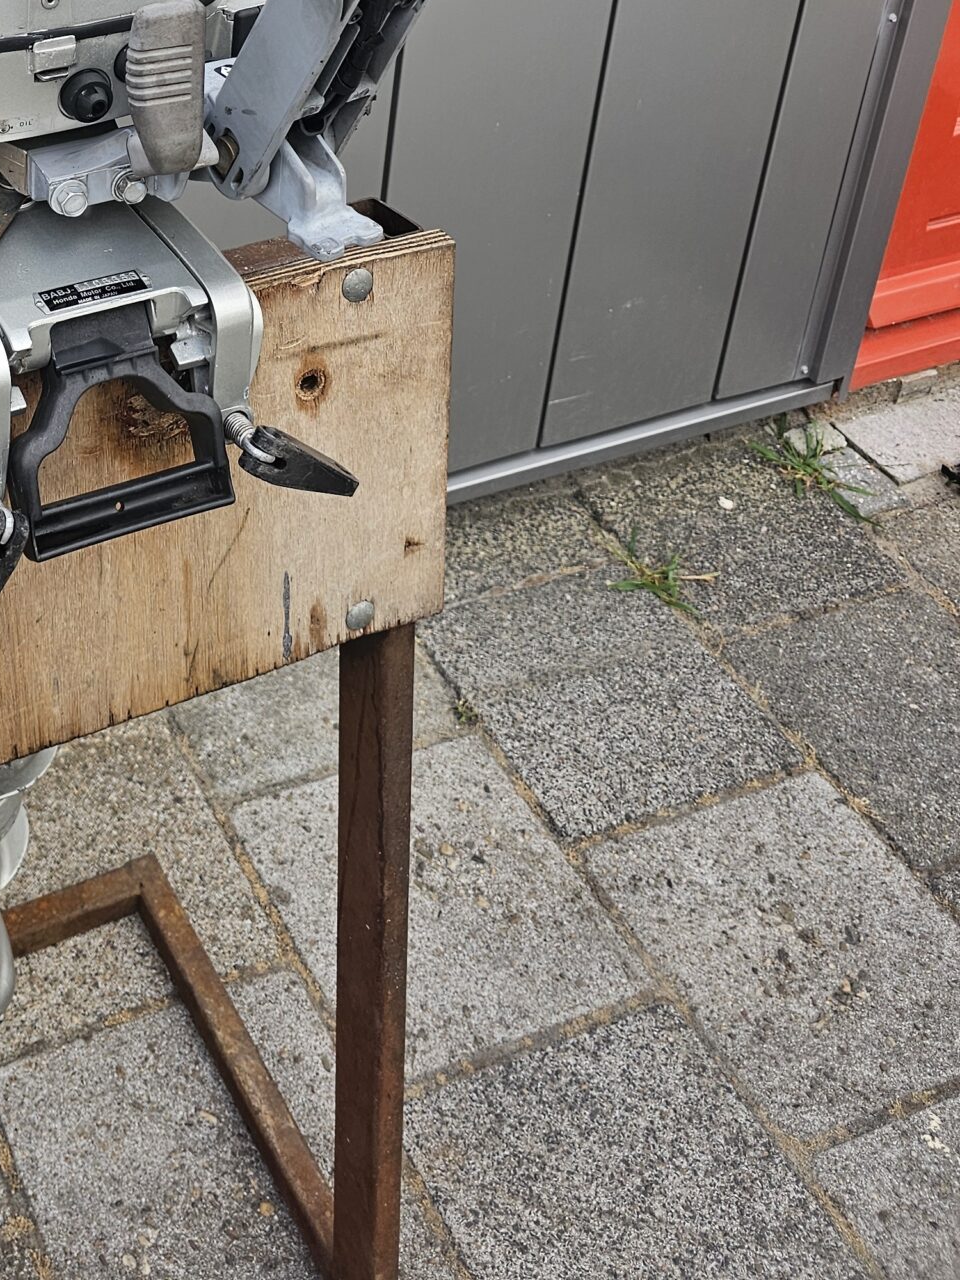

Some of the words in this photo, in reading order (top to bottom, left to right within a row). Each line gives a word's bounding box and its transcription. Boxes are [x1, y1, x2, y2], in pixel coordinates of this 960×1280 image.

[19, 120, 33, 128] OIL
[52, 295, 78, 305] Honda
[80, 288, 102, 298] Motor
